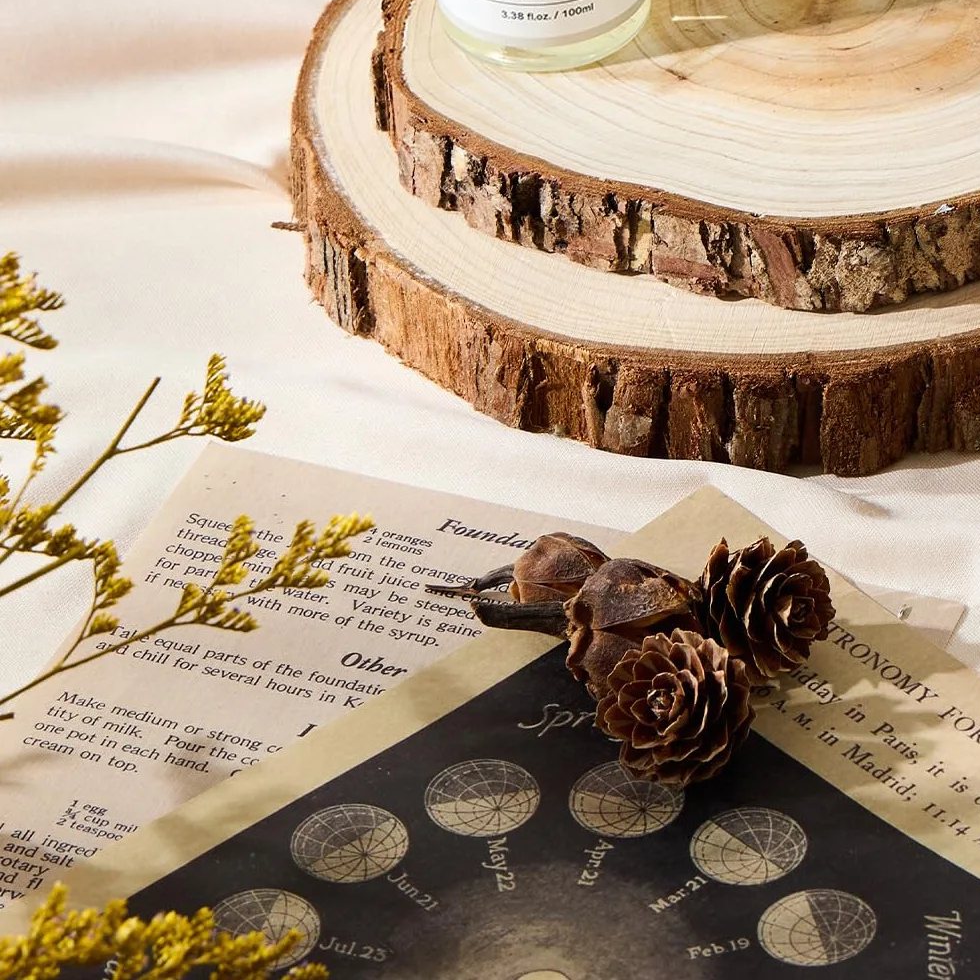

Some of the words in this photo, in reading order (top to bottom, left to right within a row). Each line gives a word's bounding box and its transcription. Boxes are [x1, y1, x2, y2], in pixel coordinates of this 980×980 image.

[501, 10, 525, 21] 3.38
[527, 12, 552, 21] fl.oz.
[562, 3, 594, 18] 100ml
[186, 513, 233, 532] Squee
[256, 530, 284, 543] the
[379, 556, 406, 570] the
[411, 565, 476, 584] oranges
[363, 536, 373, 544] 2
[376, 538, 424, 556] lemons
[369, 527, 377, 535] 4
[381, 530, 433, 549] oranges
[436, 519, 536, 550] Foundat
[165, 543, 222, 564] choppe
[343, 583, 381, 599] may
[388, 591, 408, 605] be
[337, 563, 374, 580] fruit
[378, 572, 420, 590] juice
[144, 571, 160, 583] if
[247, 595, 282, 611] with
[287, 606, 330, 621] more
[335, 616, 354, 627] of
[357, 620, 385, 634] the
[388, 628, 440, 647] syrup.
[155, 558, 180, 571] for
[283, 585, 329, 605] water.
[352, 599, 412, 624] Variety
[416, 615, 432, 628] is
[436, 620, 482, 638] gaine
[132, 649, 170, 665] chill
[173, 657, 198, 671] for
[202, 666, 262, 686] several
[265, 678, 312, 698] hours
[318, 690, 336, 703] in
[154, 638, 200, 655] equal
[203, 650, 248, 666] parts
[252, 661, 272, 671] of
[275, 663, 302, 678] the
[340, 651, 408, 677] Other
[827, 621, 939, 703] TRONOMY
[47, 706, 79, 721] tity
[82, 715, 102, 726] of
[102, 721, 143, 739] milk.
[164, 734, 205, 753] Pour
[209, 745, 237, 761] the
[57, 691, 106, 711] Make
[110, 705, 178, 730] medium
[184, 725, 204, 735] or
[207, 729, 262, 752] strong
[517, 703, 597, 738] Spr
[788, 665, 842, 705] idday
[844, 704, 866, 724] in
[870, 721, 918, 765] Paris,
[927, 761, 946, 778] it
[948, 777, 969, 794] is
[23, 736, 75, 756] cream
[80, 750, 101, 762] on
[107, 756, 138, 773] top.
[34, 722, 65, 735] one
[66, 729, 96, 743] pot
[100, 736, 118, 749] in
[121, 744, 160, 760] each
[163, 752, 209, 773] hand.
[771, 699, 787, 713] A.
[794, 713, 811, 731] M.
[817, 727, 840, 746] in
[842, 744, 916, 803] Madrid;
[923, 802, 971, 836] 11.14
[56, 818, 67, 826] 2
[70, 800, 79, 808] 1
[82, 804, 108, 817] egg
[83, 815, 110, 828] cup
[3, 842, 39, 858] and
[40, 852, 75, 868] salt
[10, 829, 36, 842] all
[41, 834, 99, 858] ingred
